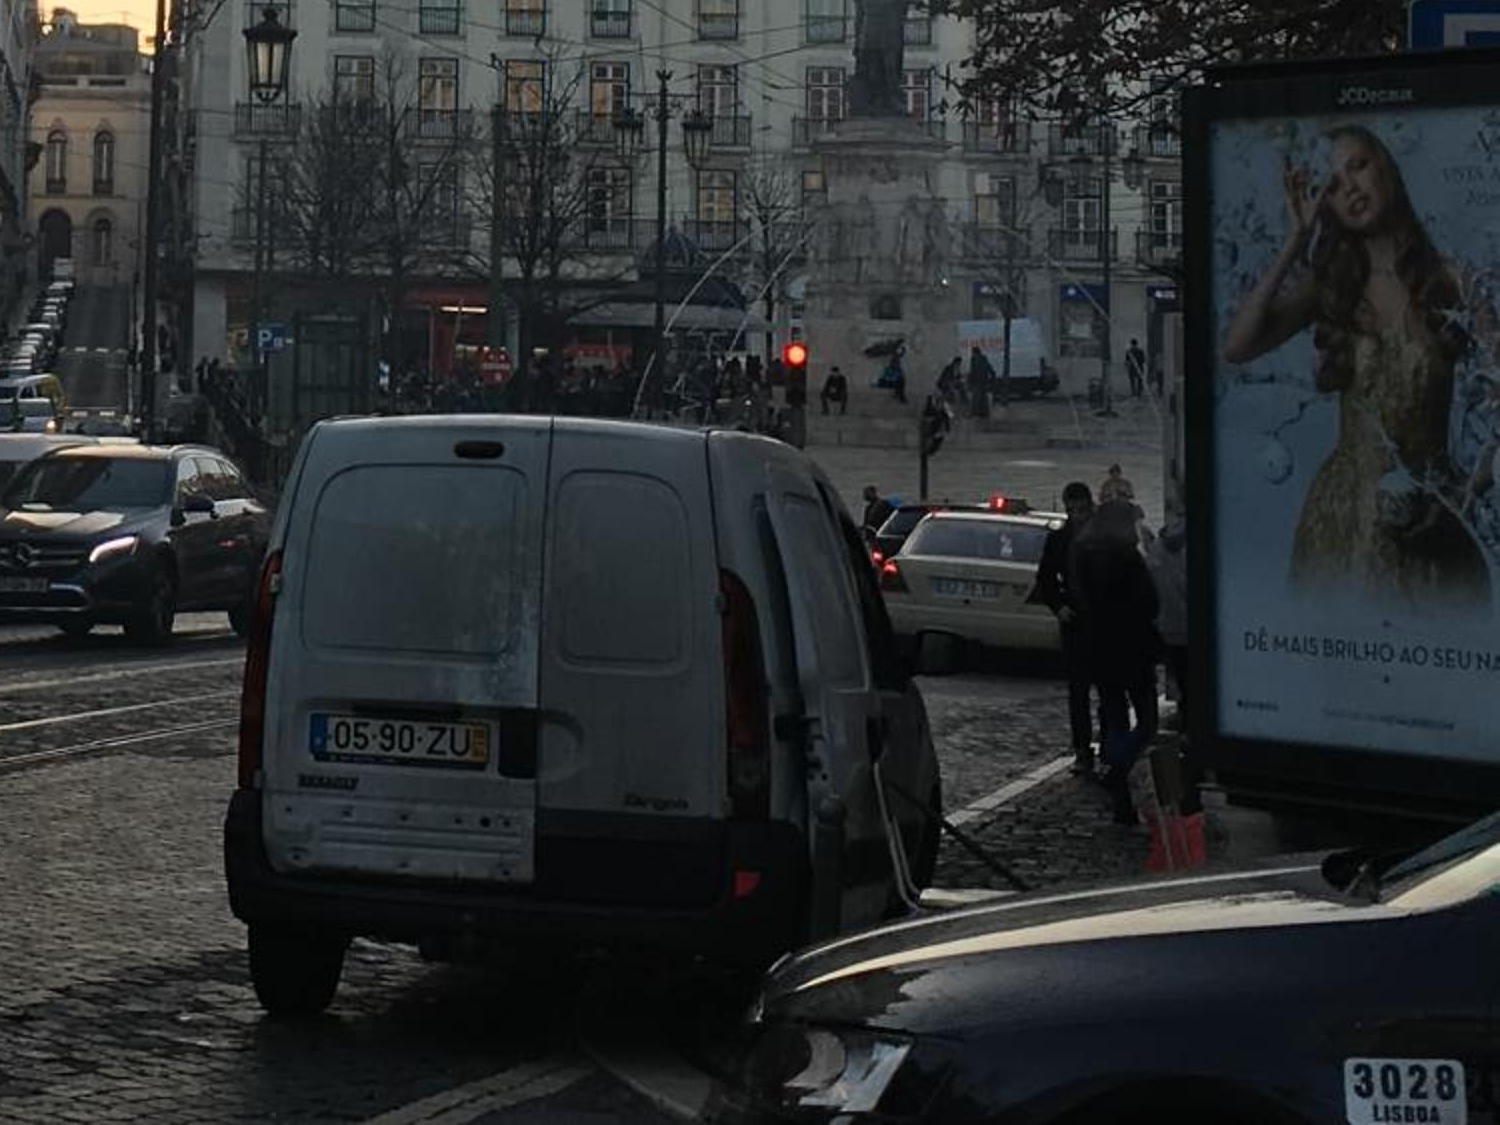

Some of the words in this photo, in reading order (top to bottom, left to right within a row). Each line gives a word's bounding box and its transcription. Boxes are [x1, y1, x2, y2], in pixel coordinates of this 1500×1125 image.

[1243, 626, 1268, 652] DÊ
[1272, 635, 1318, 657] MAIS
[1322, 638, 1395, 664] BRILHO
[1399, 645, 1429, 666] AO
[1433, 648, 1471, 671] SEU
[1353, 1063, 1456, 1100] 3028
[1373, 1104, 1440, 1123] LISBOA
